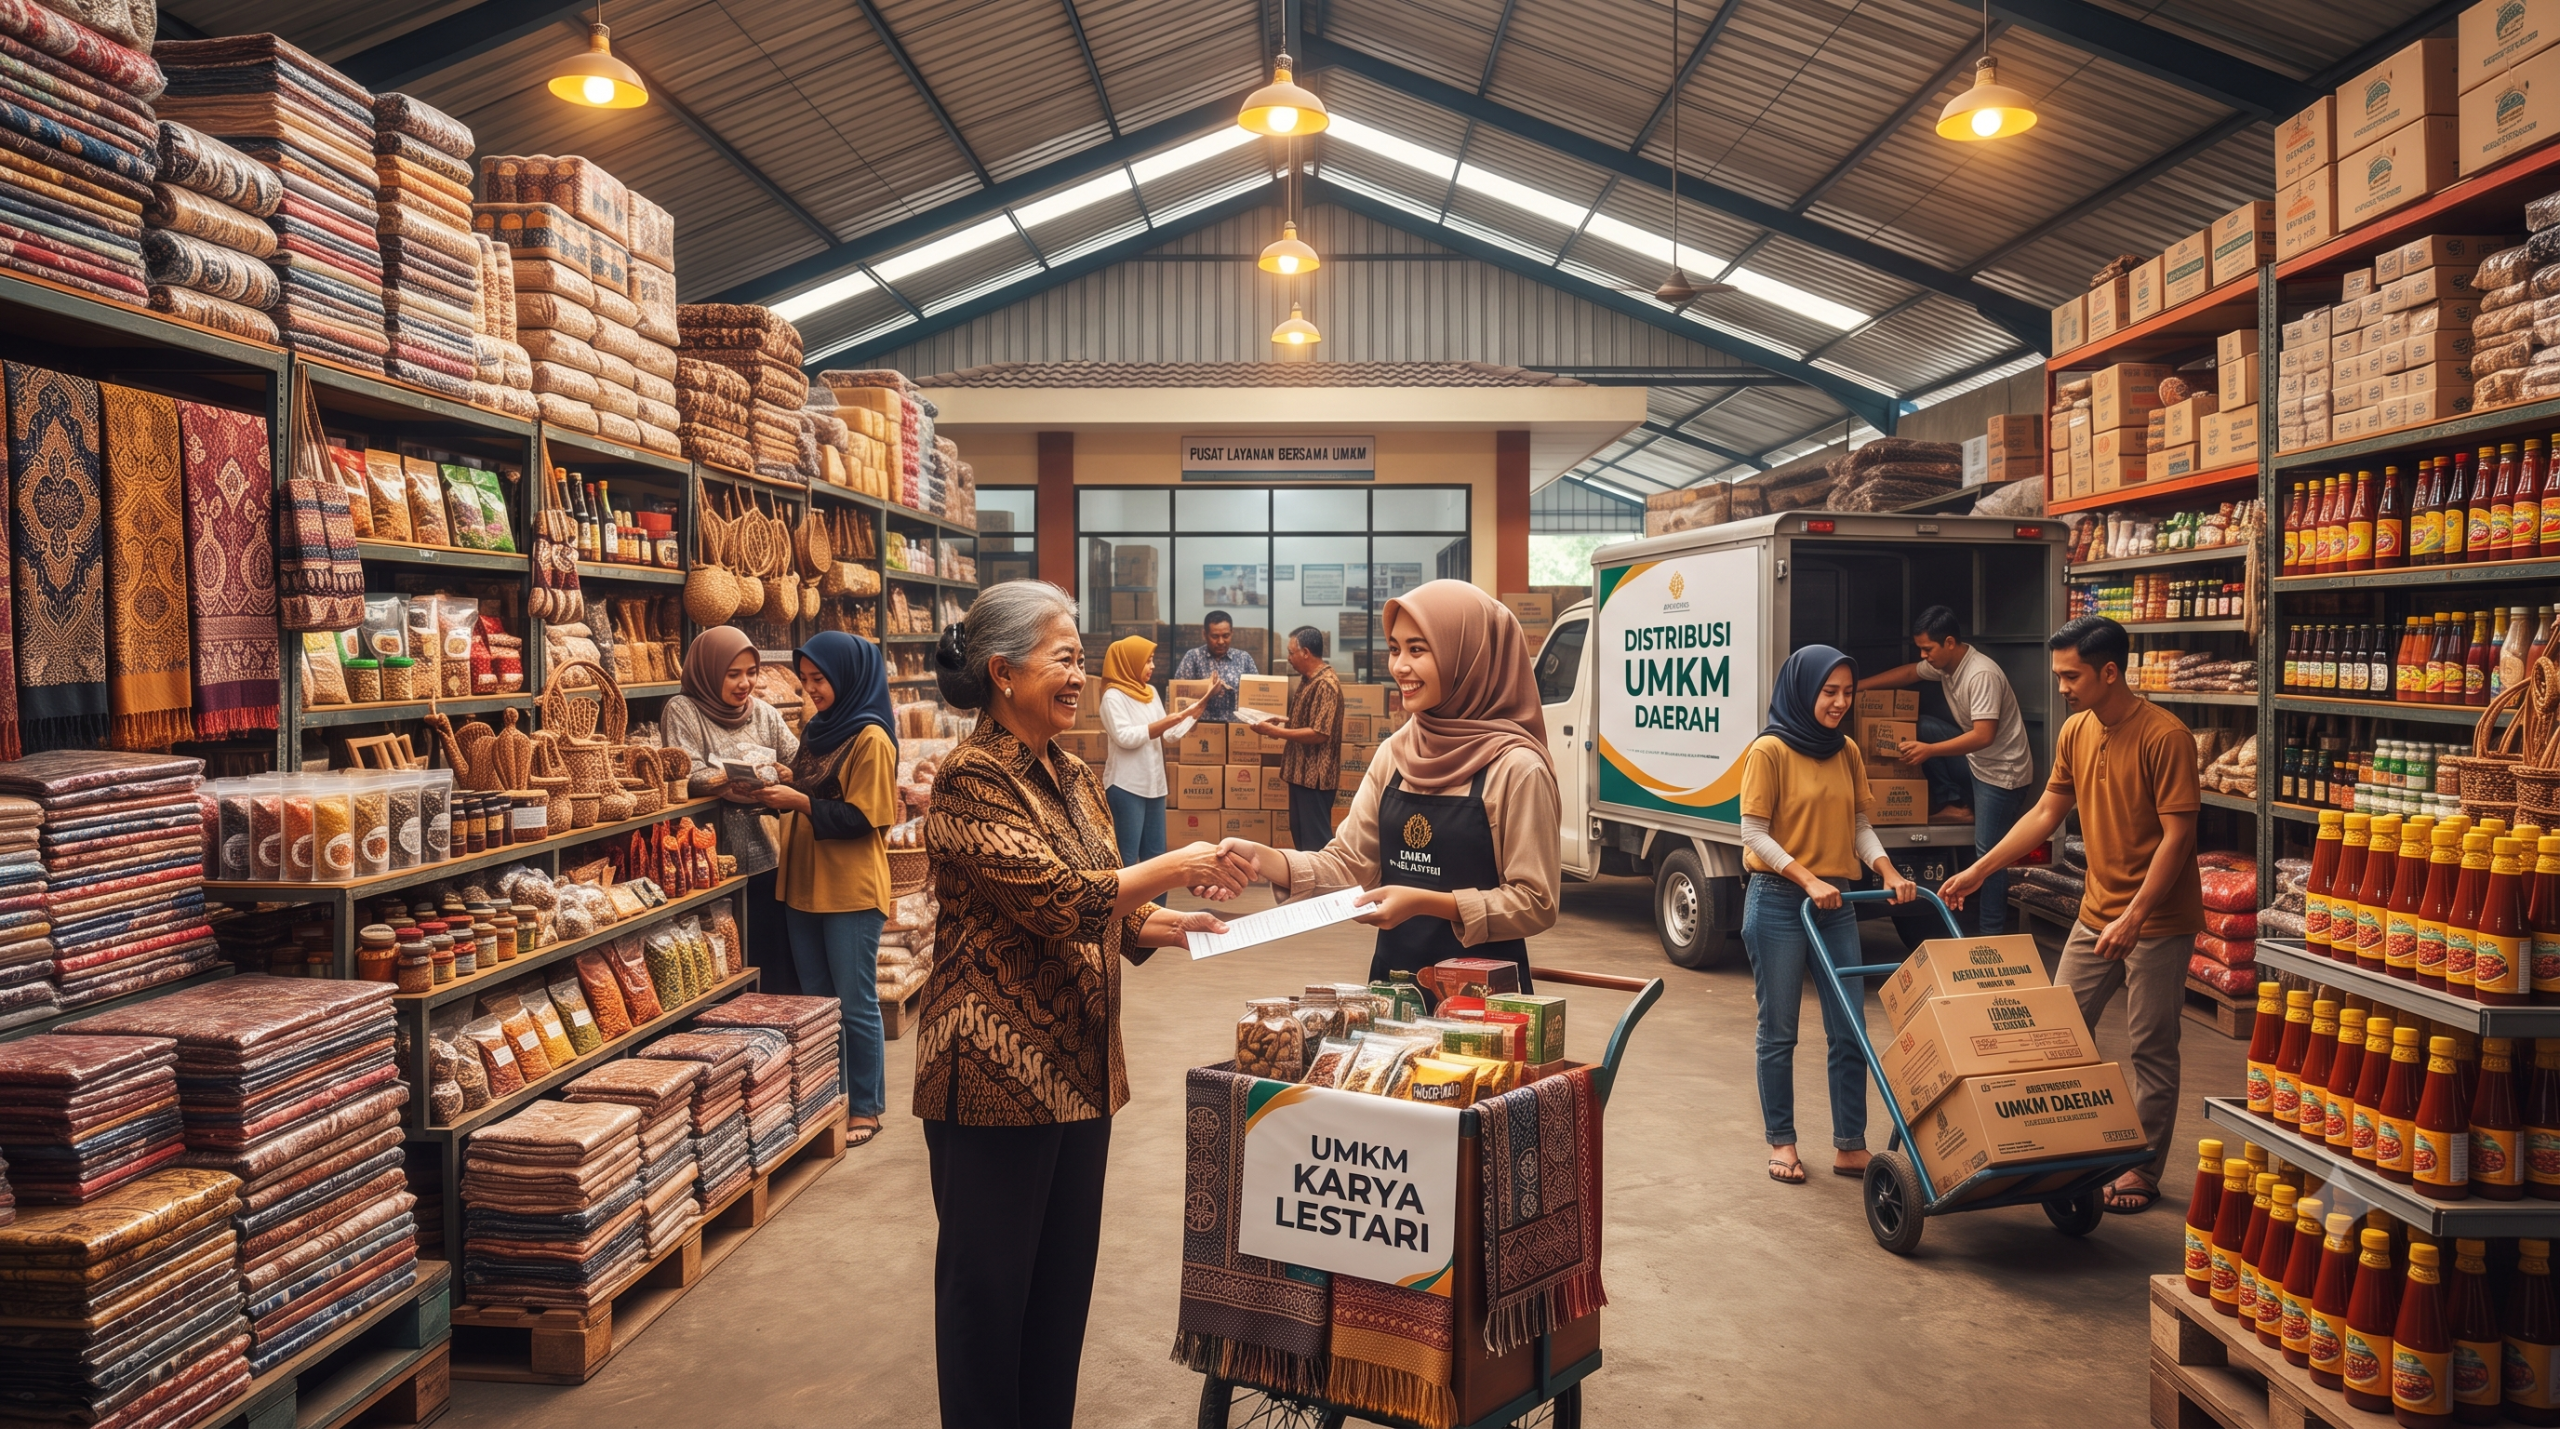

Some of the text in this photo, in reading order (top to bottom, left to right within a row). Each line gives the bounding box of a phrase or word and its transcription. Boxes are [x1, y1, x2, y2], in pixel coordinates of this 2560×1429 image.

[1190, 447, 1367, 461] PUSAT LAYANAN BERSAMA UMKM
[1624, 621, 1731, 652] DISTRIBUSI
[1625, 655, 1730, 697] UMKM
[1635, 705, 1720, 733] DAERAH
[1995, 1096, 2049, 1119] UMKM
[2050, 1088, 2115, 1112] DAERAH
[1311, 1134, 1408, 1173] UMKM
[1294, 1163, 1425, 1216] KARYA
[1275, 1196, 1429, 1253] LESTARI
